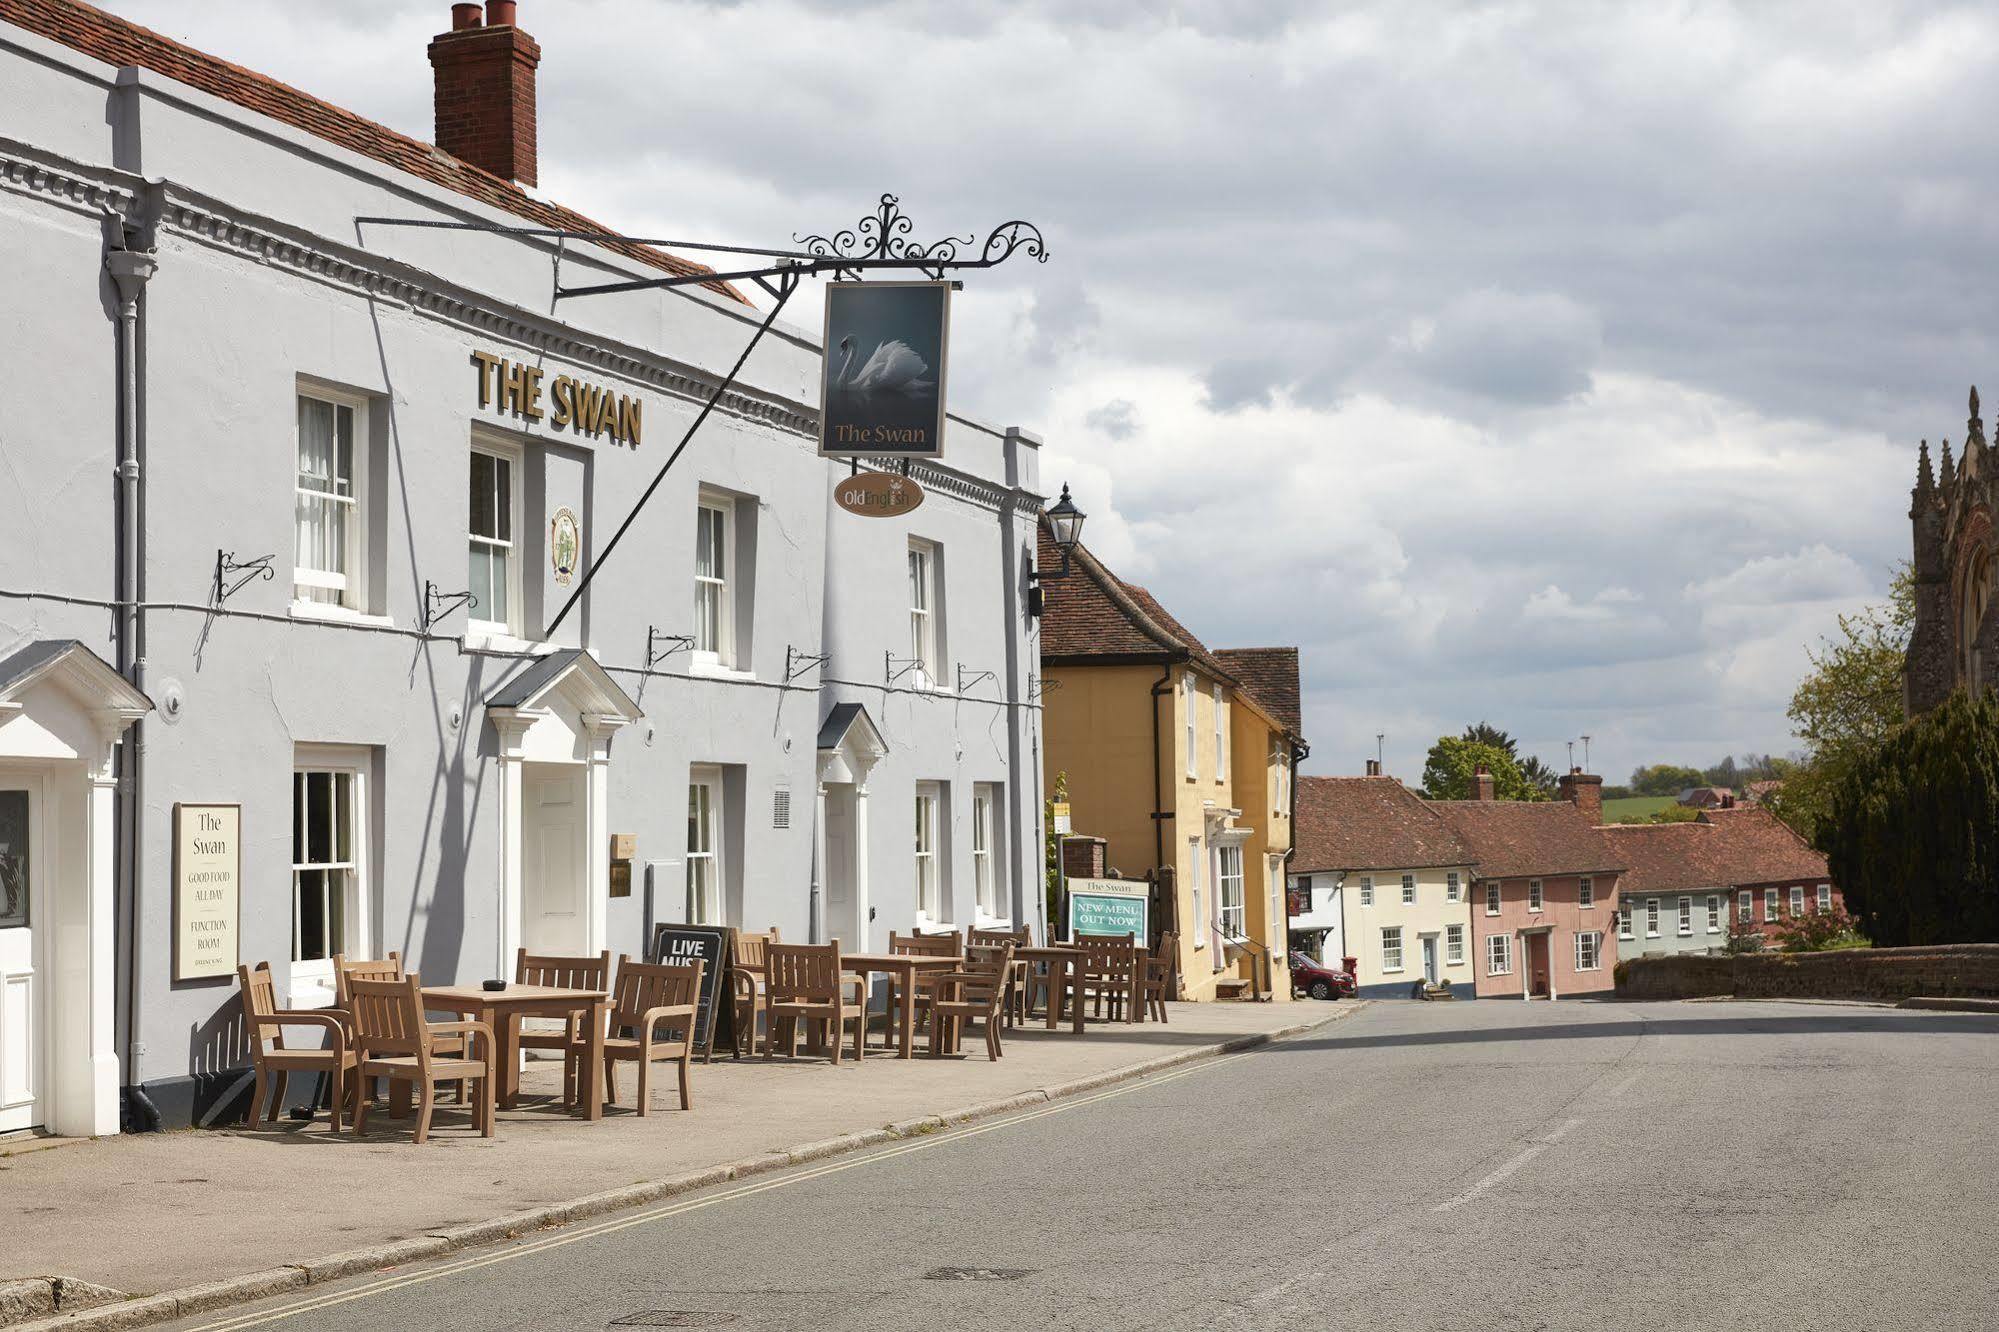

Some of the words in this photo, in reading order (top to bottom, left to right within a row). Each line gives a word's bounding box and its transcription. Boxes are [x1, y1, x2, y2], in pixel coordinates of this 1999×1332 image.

[474, 350, 545, 419] THE
[553, 374, 642, 445] SWAN
[835, 424, 871, 442] The
[874, 425, 926, 443] Swan
[197, 812, 222, 831] The
[193, 837, 227, 855] Swan
[188, 871, 210, 883] GOOD
[210, 871, 231, 883] FOOD
[1087, 882, 1104, 891] The
[1105, 883, 1132, 893] Swan
[194, 889, 209, 901] ALL
[1077, 903, 1104, 913] NEW
[1105, 904, 1139, 915] MENU
[191, 920, 228, 932] FUNCTION
[1079, 914, 1105, 924] OUT
[1107, 916, 1137, 926] NOW
[197, 938, 220, 950] ROOM
[671, 939, 705, 956] LIVE
